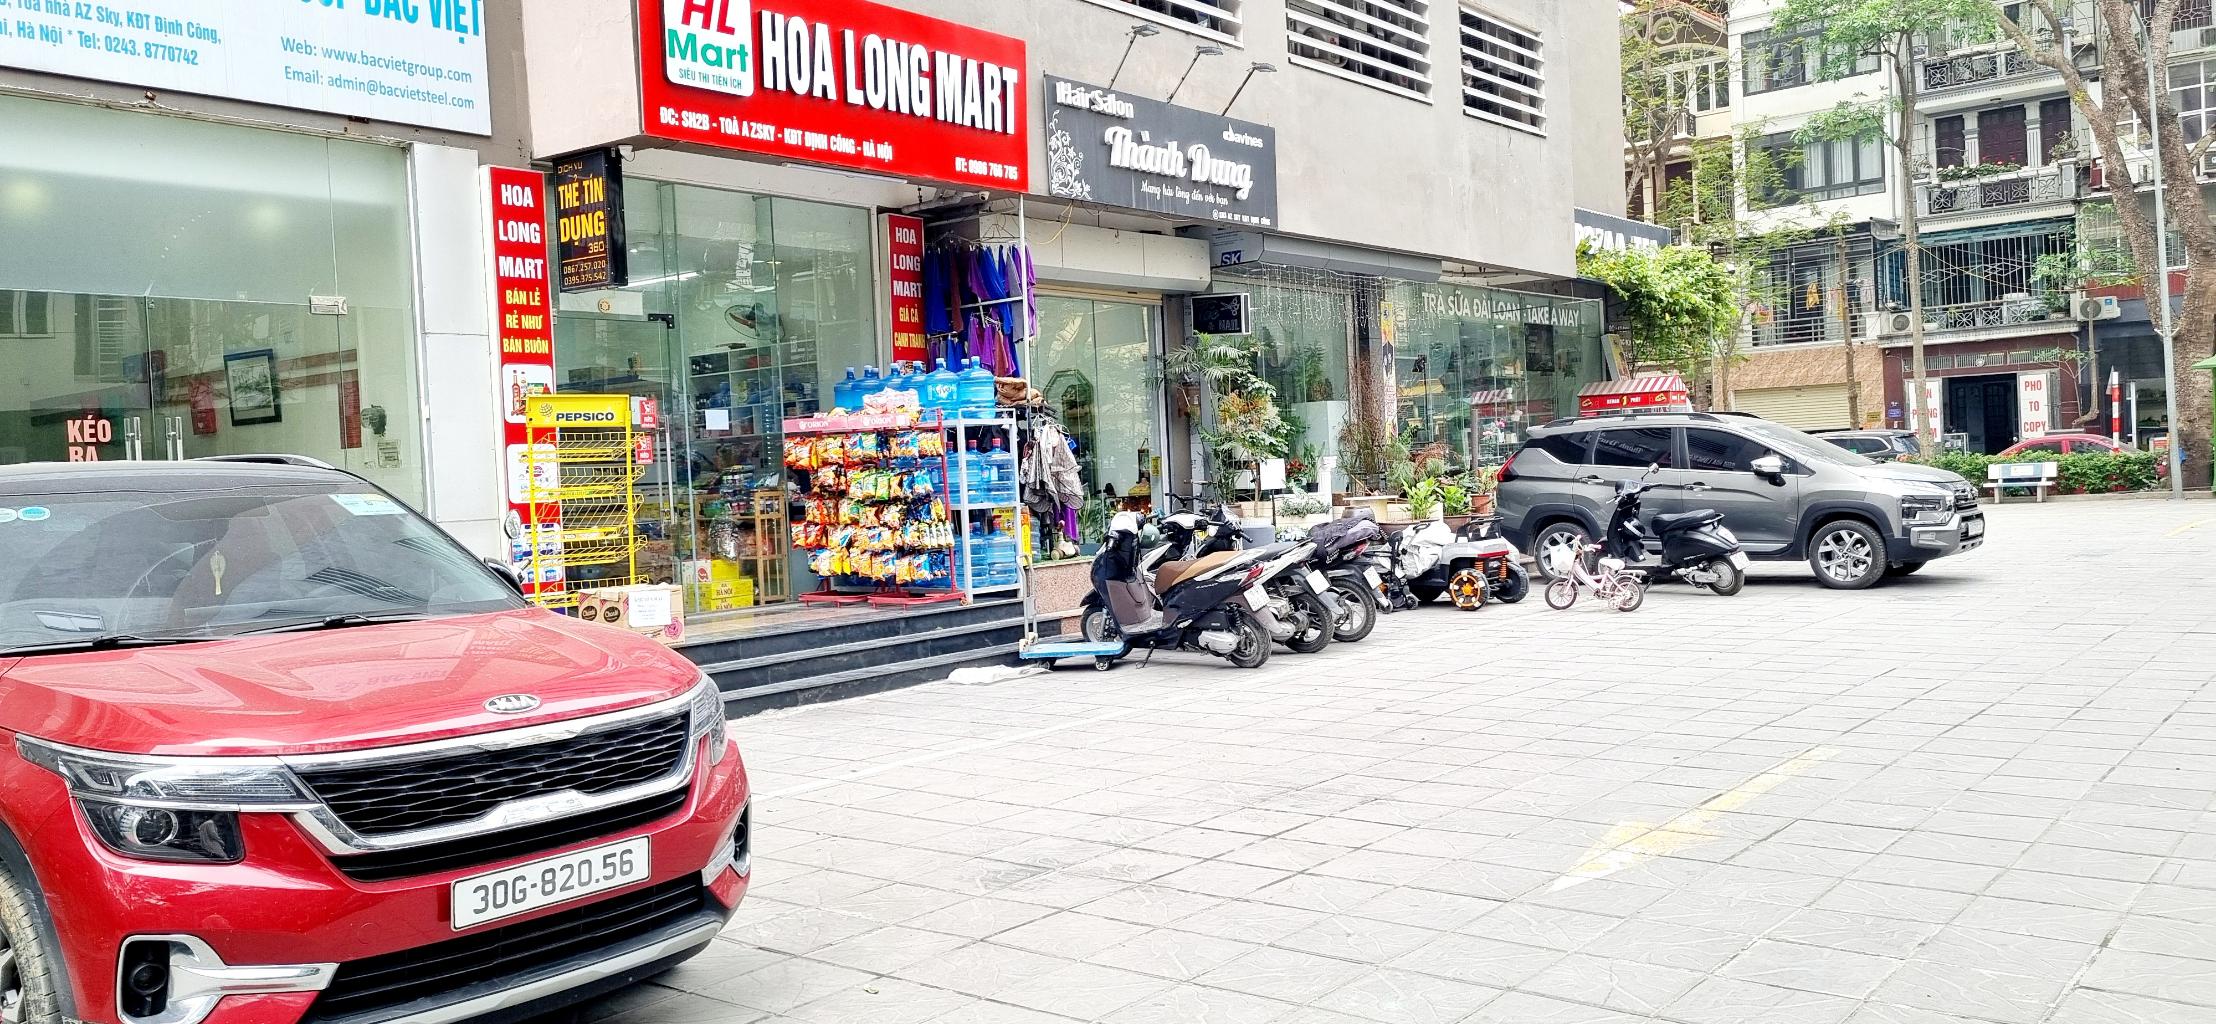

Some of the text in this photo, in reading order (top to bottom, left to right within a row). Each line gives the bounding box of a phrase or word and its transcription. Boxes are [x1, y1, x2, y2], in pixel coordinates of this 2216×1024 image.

[75, 3, 93, 21] AZ
[96, 6, 123, 27] Sky,
[126, 11, 150, 30] KĐT
[155, 15, 183, 37] Định
[187, 21, 221, 44] Công,
[681, 0, 735, 35] HL
[17, 20, 35, 39] Hà
[39, 24, 63, 47] Nội
[77, 30, 101, 50] Tel:
[105, 35, 141, 57] 0243.
[144, 42, 199, 66] 8770742
[668, 29, 749, 72] Mart
[281, 36, 472, 83] Web: www.bacvietgroup.com
[759, 10, 1018, 135] HOA LONG MART
[285, 65, 474, 109] Email: admin@bacvietsteel.com
[1055, 81, 1134, 118] Hair Salon
[660, 106, 679, 126] ĐC:
[681, 110, 710, 131] SH2B
[719, 115, 740, 135] TOÀ
[784, 127, 802, 145] KĐT
[804, 131, 828, 151] ĐỊNH
[830, 133, 855, 154] CÔNG
[863, 138, 875, 157] HÀ
[1187, 143, 1253, 200] Dung
[501, 184, 534, 208] HOA
[558, 174, 604, 210] THẺ TÍN
[1141, 179, 1161, 200] Mang
[498, 219, 540, 244] LONG
[559, 210, 605, 246] DỤNG
[895, 226, 917, 245] HOA
[588, 241, 604, 254] 360
[1222, 251, 1241, 266] SK
[498, 256, 543, 280] MART
[893, 254, 920, 272] LONG
[505, 287, 541, 306] BÁN LẺ
[893, 281, 922, 298] MART
[1422, 288, 1446, 315] TRÀ
[1447, 290, 1470, 317] SỮA
[1473, 294, 1491, 319] ĐÀI
[1493, 303, 1521, 322] LOAN
[1526, 304, 1549, 324] TAKE
[506, 309, 542, 329] RẺ NHƯ
[503, 336, 548, 354] BÁN BUÔN
[2024, 380, 2043, 392] PHO
[555, 410, 615, 422] PEPSICO
[2029, 400, 2040, 412] TO
[67, 414, 112, 443] KÉO
[807, 420, 829, 428] ORION
[2023, 420, 2047, 433] COPY
[496, 695, 533, 710] KIA
[472, 848, 634, 915] 30G-820.56
